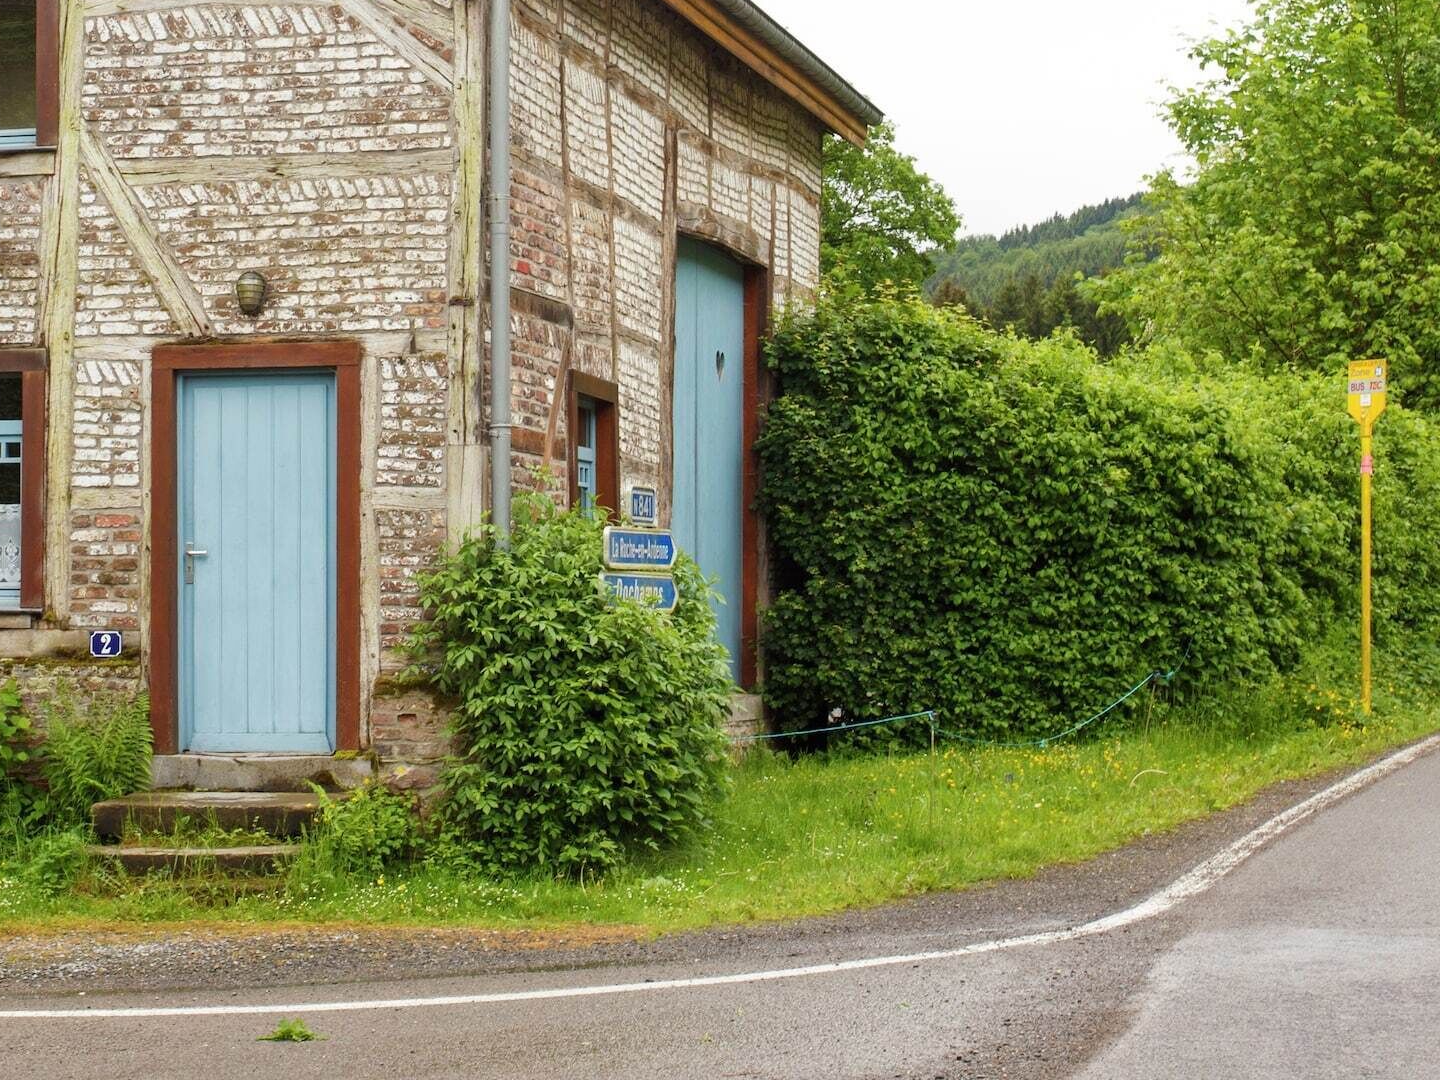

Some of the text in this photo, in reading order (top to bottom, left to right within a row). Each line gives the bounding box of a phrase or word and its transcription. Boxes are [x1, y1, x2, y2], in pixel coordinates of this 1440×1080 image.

[1350, 383, 1364, 392] BUS
[612, 536, 669, 560] La Roche-en-Ardenne
[100, 633, 112, 654] 2
